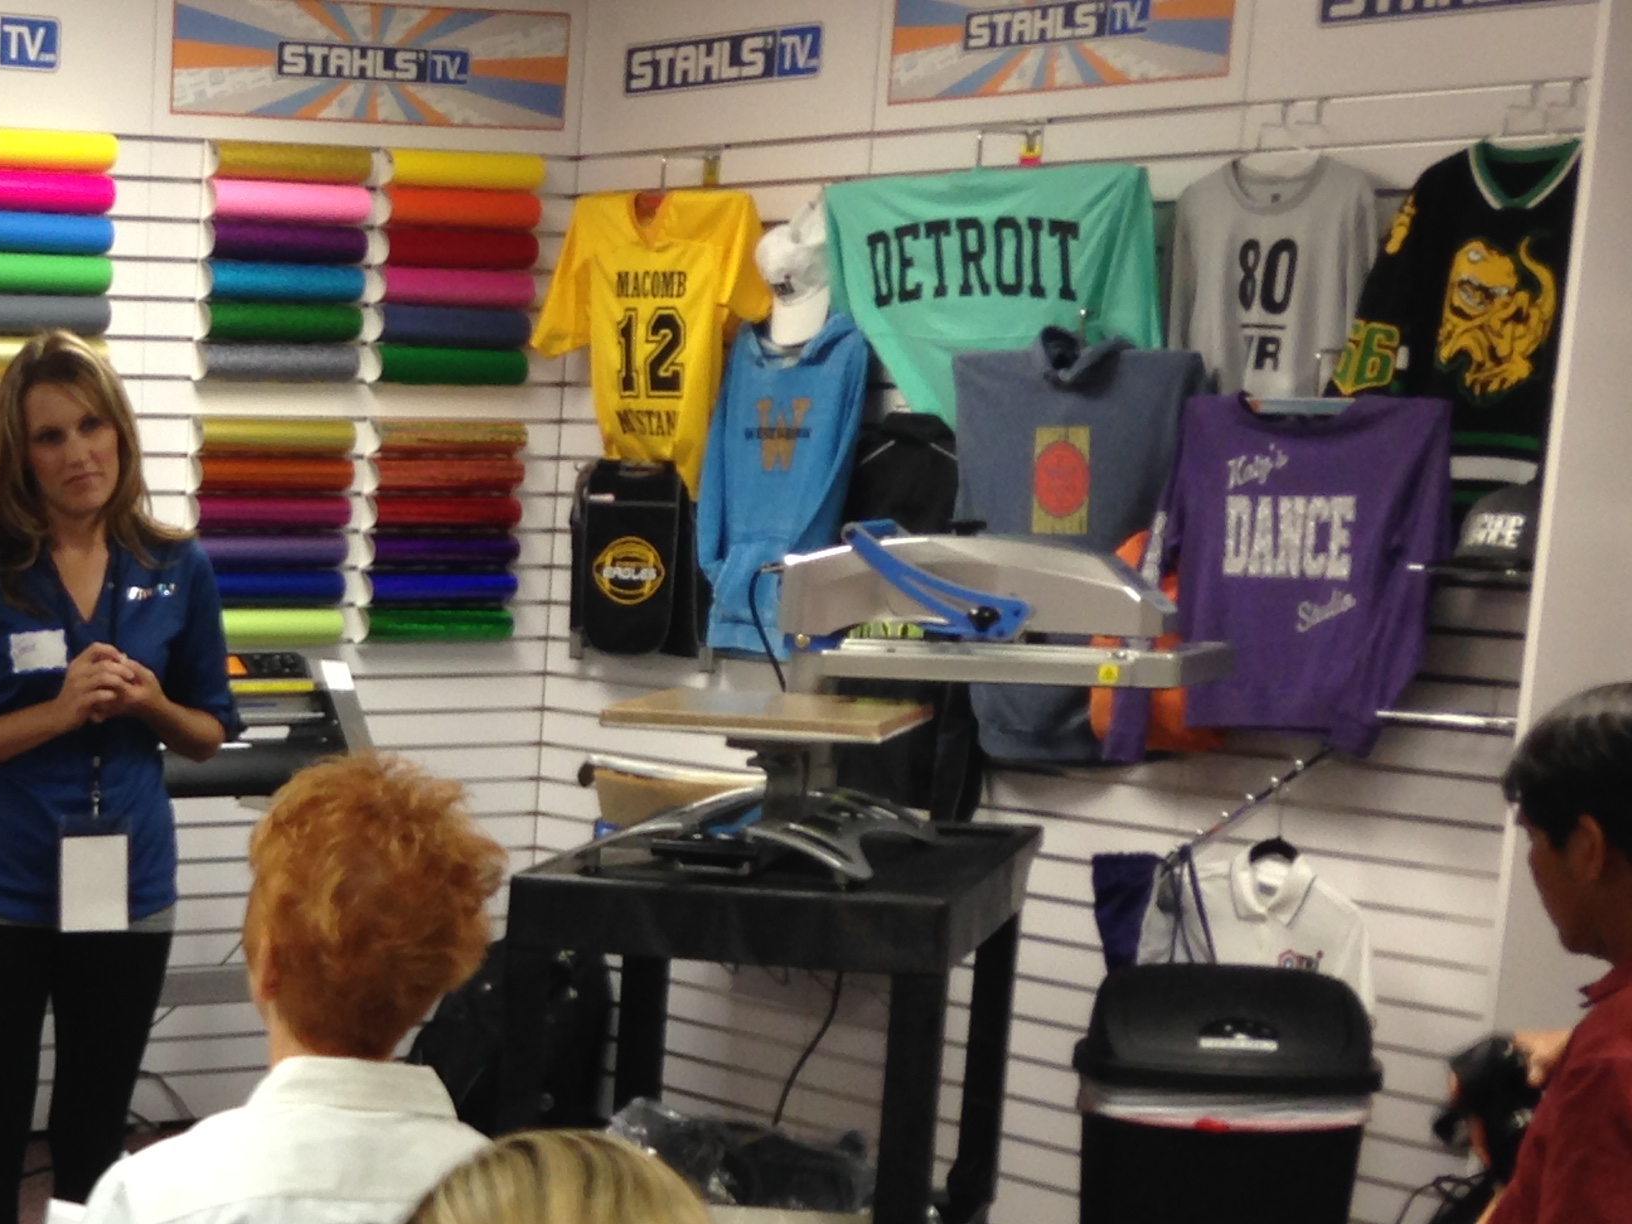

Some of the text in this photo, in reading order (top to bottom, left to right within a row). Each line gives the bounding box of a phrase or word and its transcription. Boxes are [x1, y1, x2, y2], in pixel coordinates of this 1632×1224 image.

[281, 44, 425, 80] STAHLS'
[630, 35, 773, 90] STAHLS'
[616, 271, 687, 298] MACOMB
[867, 215, 1079, 307] DETROIT
[1239, 238, 1298, 314] 80
[617, 306, 687, 398] 12
[1223, 495, 1357, 581] DANCE
